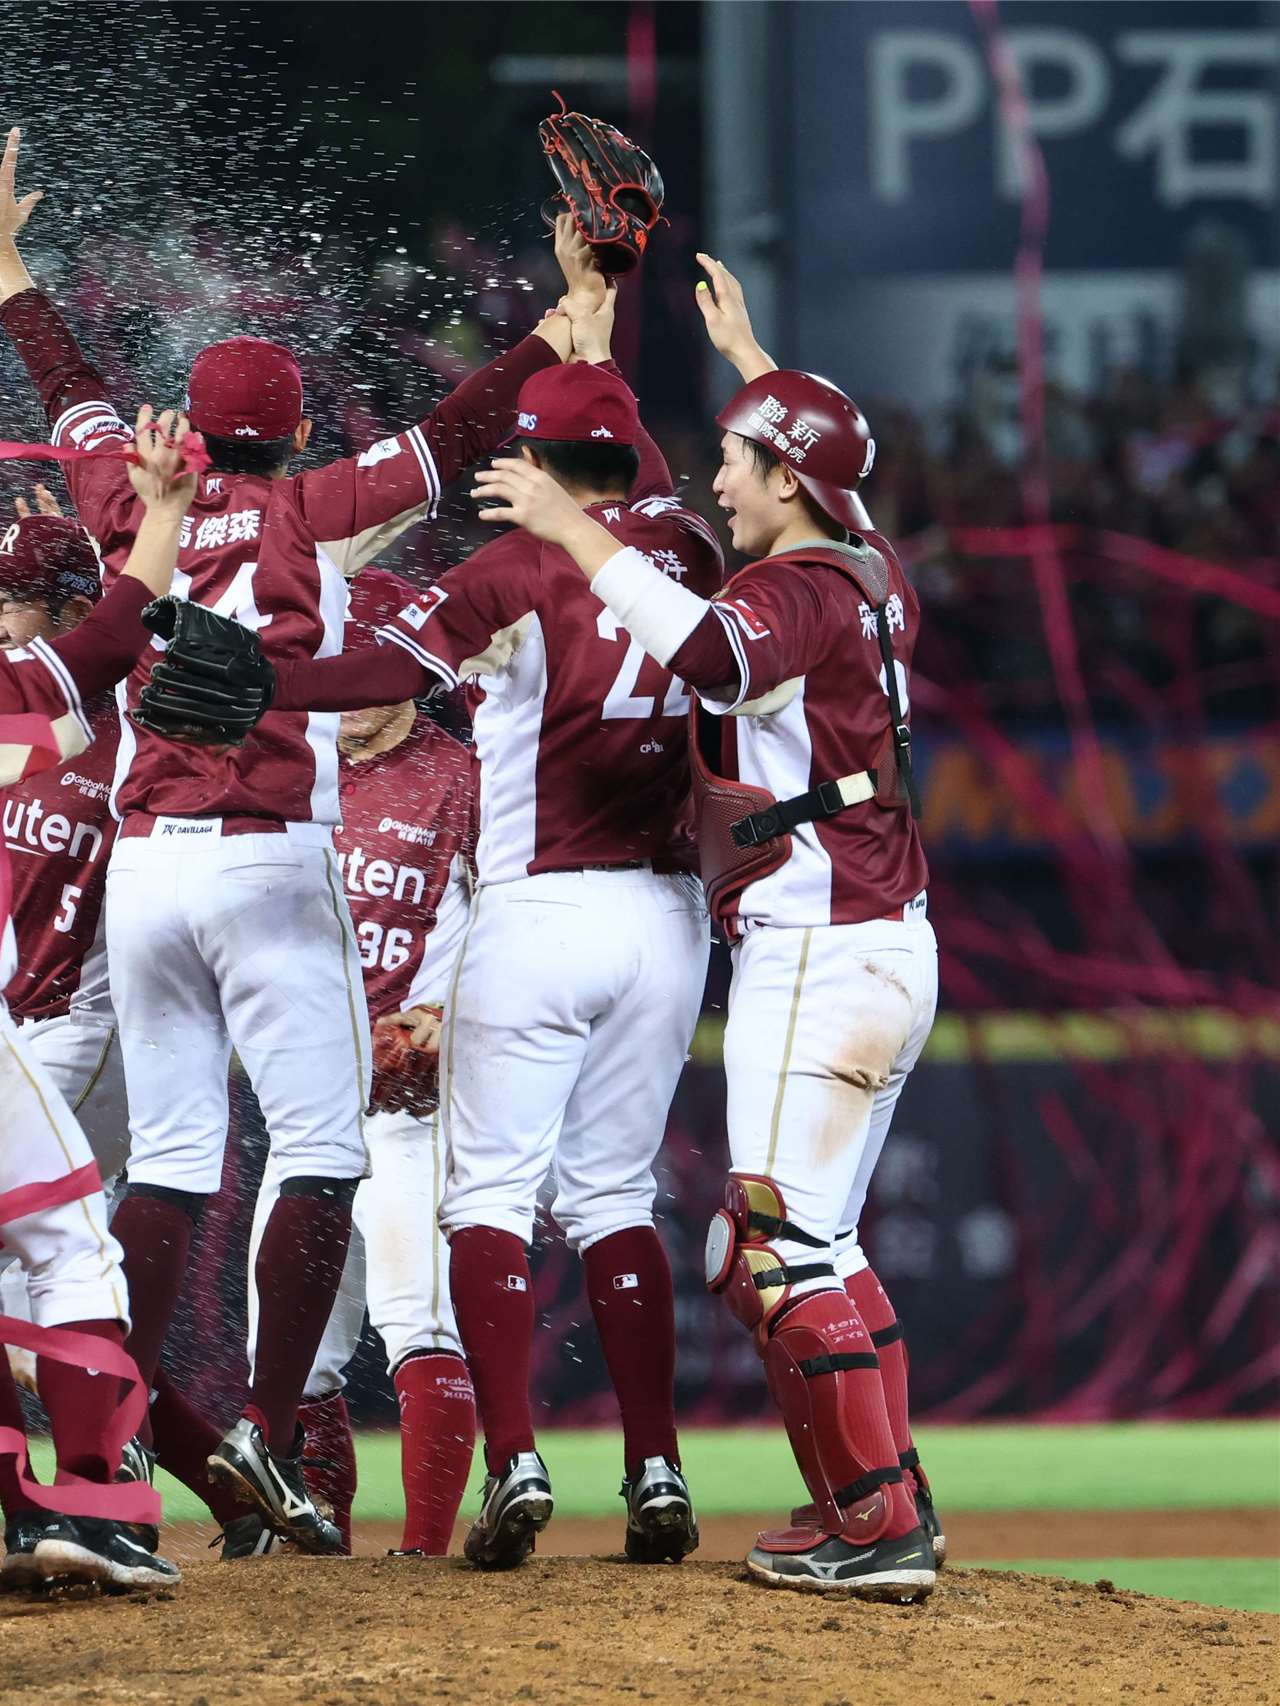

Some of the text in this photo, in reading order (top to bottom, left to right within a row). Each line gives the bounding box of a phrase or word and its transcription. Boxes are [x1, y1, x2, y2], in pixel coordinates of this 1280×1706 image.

[757, 394, 821, 450] 聯新
[53, 883, 82, 933] 5
[357, 921, 413, 972] 36
